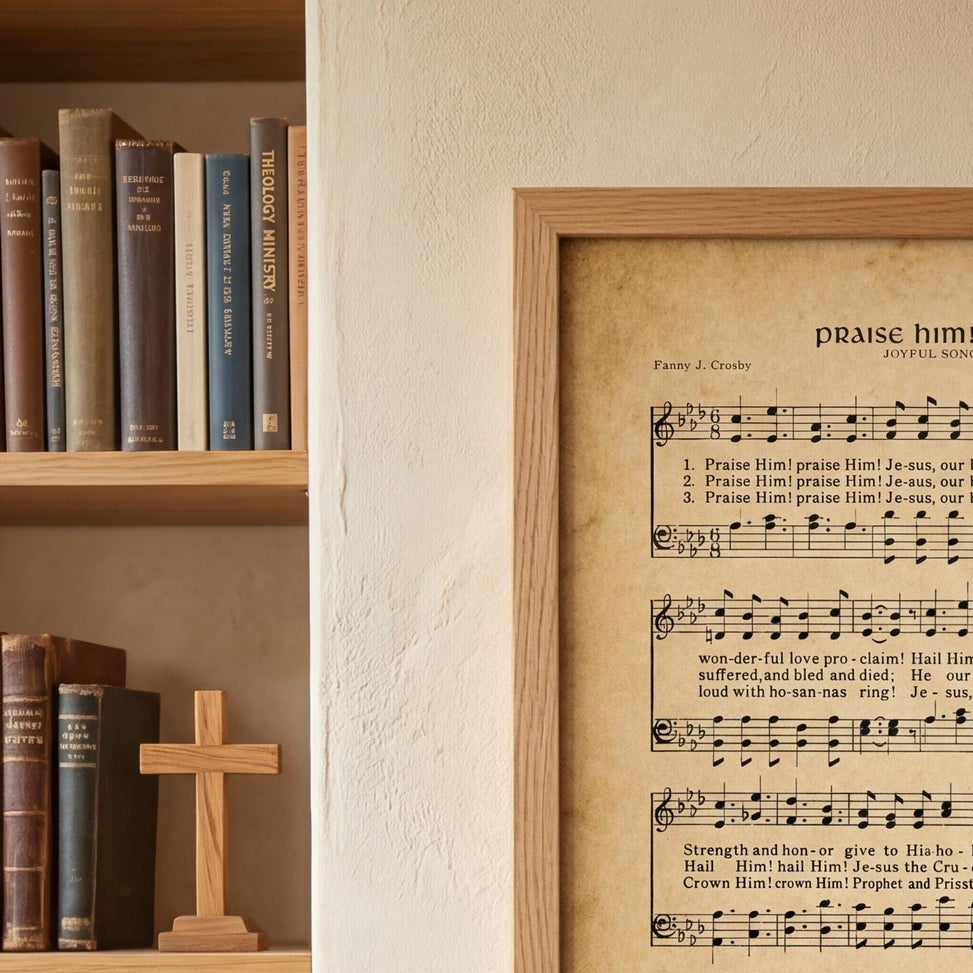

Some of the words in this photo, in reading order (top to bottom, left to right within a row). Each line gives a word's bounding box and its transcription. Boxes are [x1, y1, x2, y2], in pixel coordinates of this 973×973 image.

[261, 149, 276, 225] THEOLOGY
[263, 229, 277, 293] MINISTRY
[882, 347, 937, 359] JOYFUL
[653, 359, 691, 373] Fanny
[694, 359, 707, 370] J.
[710, 359, 752, 373] Crosby
[683, 458, 695, 471] 1.
[704, 457, 751, 472] Praise
[754, 457, 792, 472] Him!
[795, 457, 841, 475] praise
[844, 457, 881, 472] Him!
[939, 461, 966, 472] our
[682, 474, 695, 488] 2.
[704, 474, 751, 488] Praise
[755, 474, 793, 488] Him!
[796, 474, 841, 491] praise
[844, 474, 882, 488] Him!
[939, 477, 966, 488] our
[682, 490, 695, 504] 3.
[704, 490, 751, 504] Praise
[755, 490, 792, 504] Him!
[795, 490, 841, 508] praise
[844, 490, 882, 504] Him!
[939, 494, 965, 504] our
[788, 650, 820, 665] love
[910, 651, 942, 666] Hail
[793, 667, 825, 682] bled
[829, 667, 856, 682] and
[858, 667, 895, 684] died;
[910, 668, 933, 682] He
[945, 671, 972, 682] our
[698, 684, 729, 698] loud
[731, 684, 766, 699] with
[859, 684, 896, 702] ring!
[683, 842, 749, 860] Strength
[752, 843, 779, 857] and
[844, 843, 876, 860] give
[684, 859, 715, 873] Hail
[735, 859, 773, 873] Him!
[776, 859, 806, 873] hail
[810, 859, 848, 873] Him!
[904, 859, 928, 874] the
[682, 875, 731, 890] Crown
[734, 875, 774, 890] Him!
[774, 875, 813, 889] crown
[815, 876, 849, 890] Him!
[851, 876, 904, 893] Prophet
[906, 876, 931, 890] and
